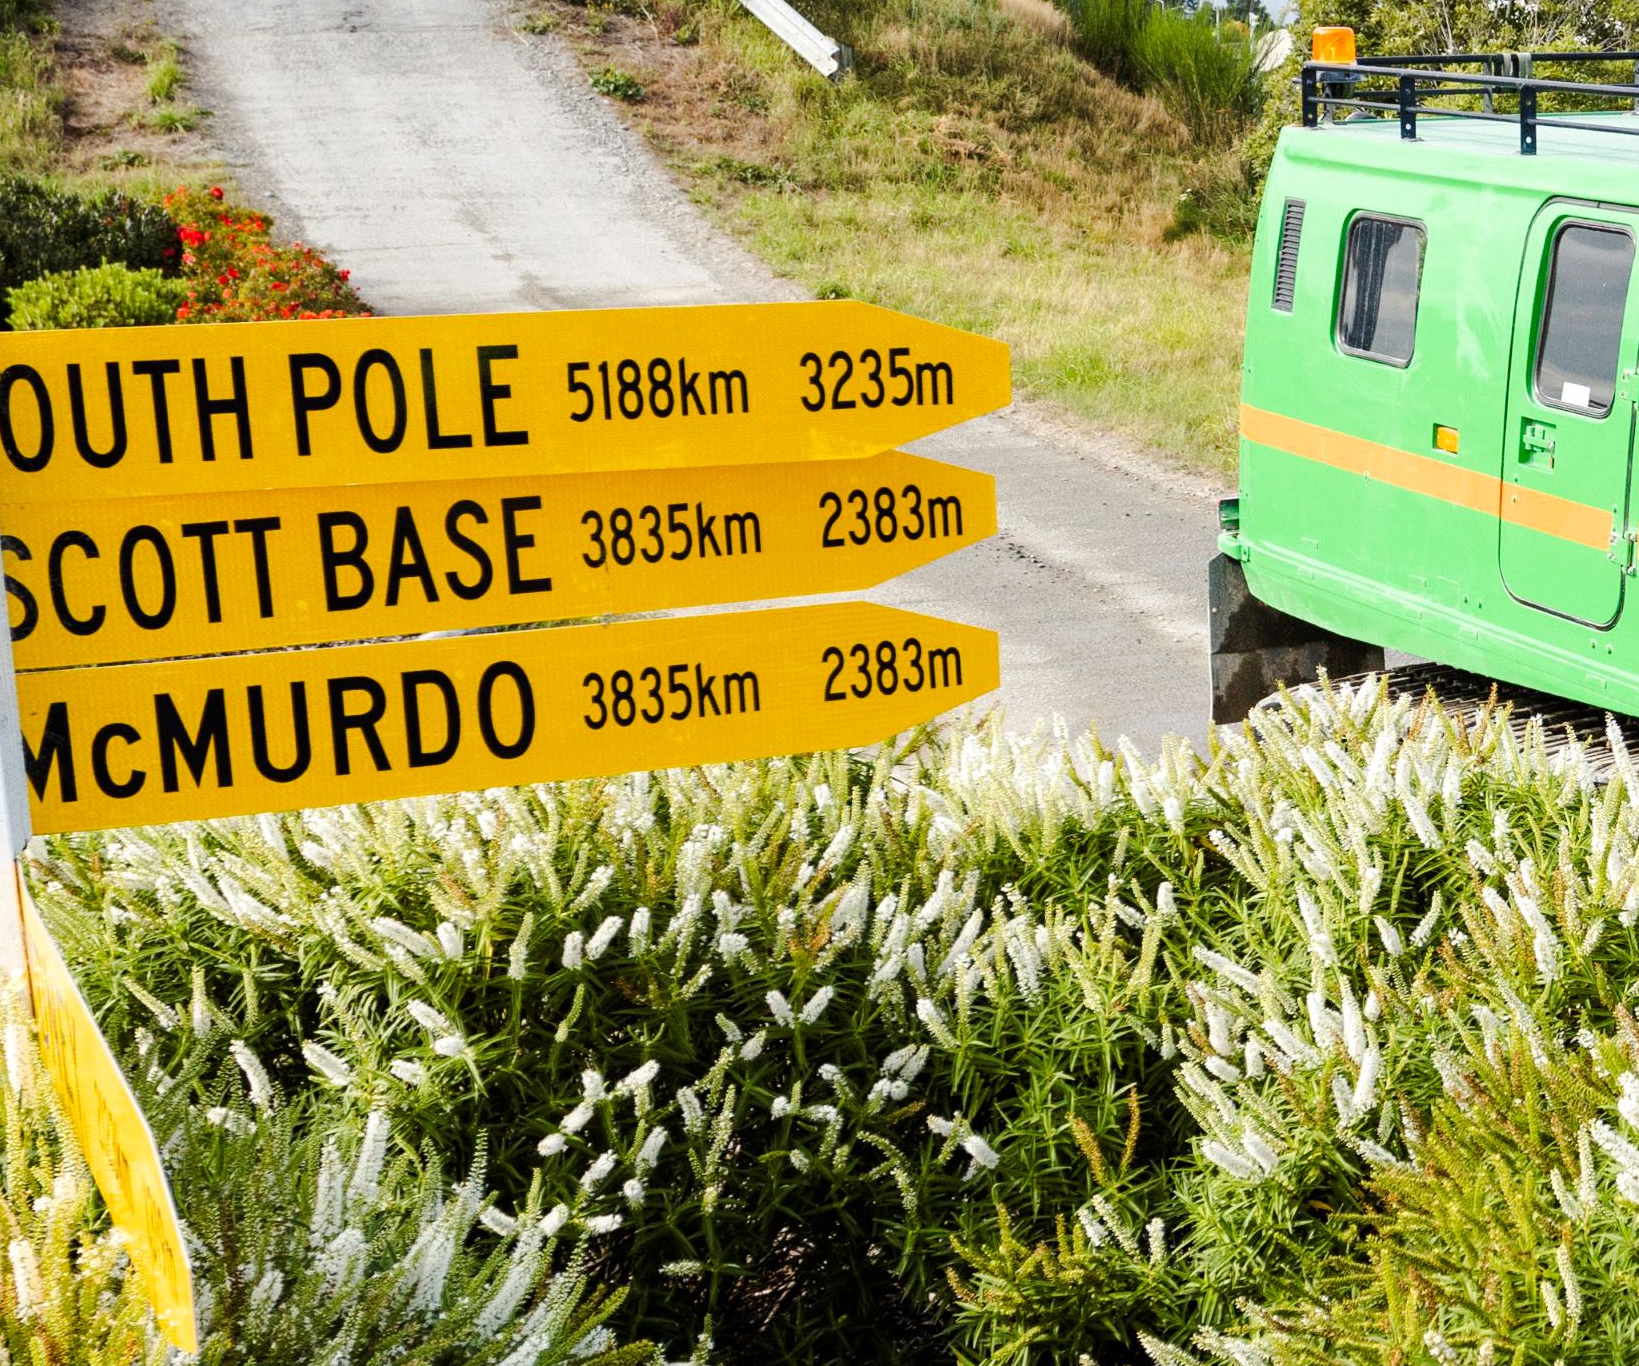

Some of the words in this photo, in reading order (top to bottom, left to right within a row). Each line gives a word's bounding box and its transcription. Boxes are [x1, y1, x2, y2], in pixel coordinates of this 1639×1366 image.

[288, 344, 529, 457] POLE
[567, 357, 749, 423] 5188km
[800, 347, 954, 412] 3235m
[0, 516, 280, 642] SCOTT
[317, 495, 552, 612] BASE
[581, 502, 762, 569] 3835km
[819, 484, 963, 548] 2383m
[20, 660, 536, 803] McMURDO
[583, 663, 760, 730] 3835km
[822, 637, 963, 702] 2383m
